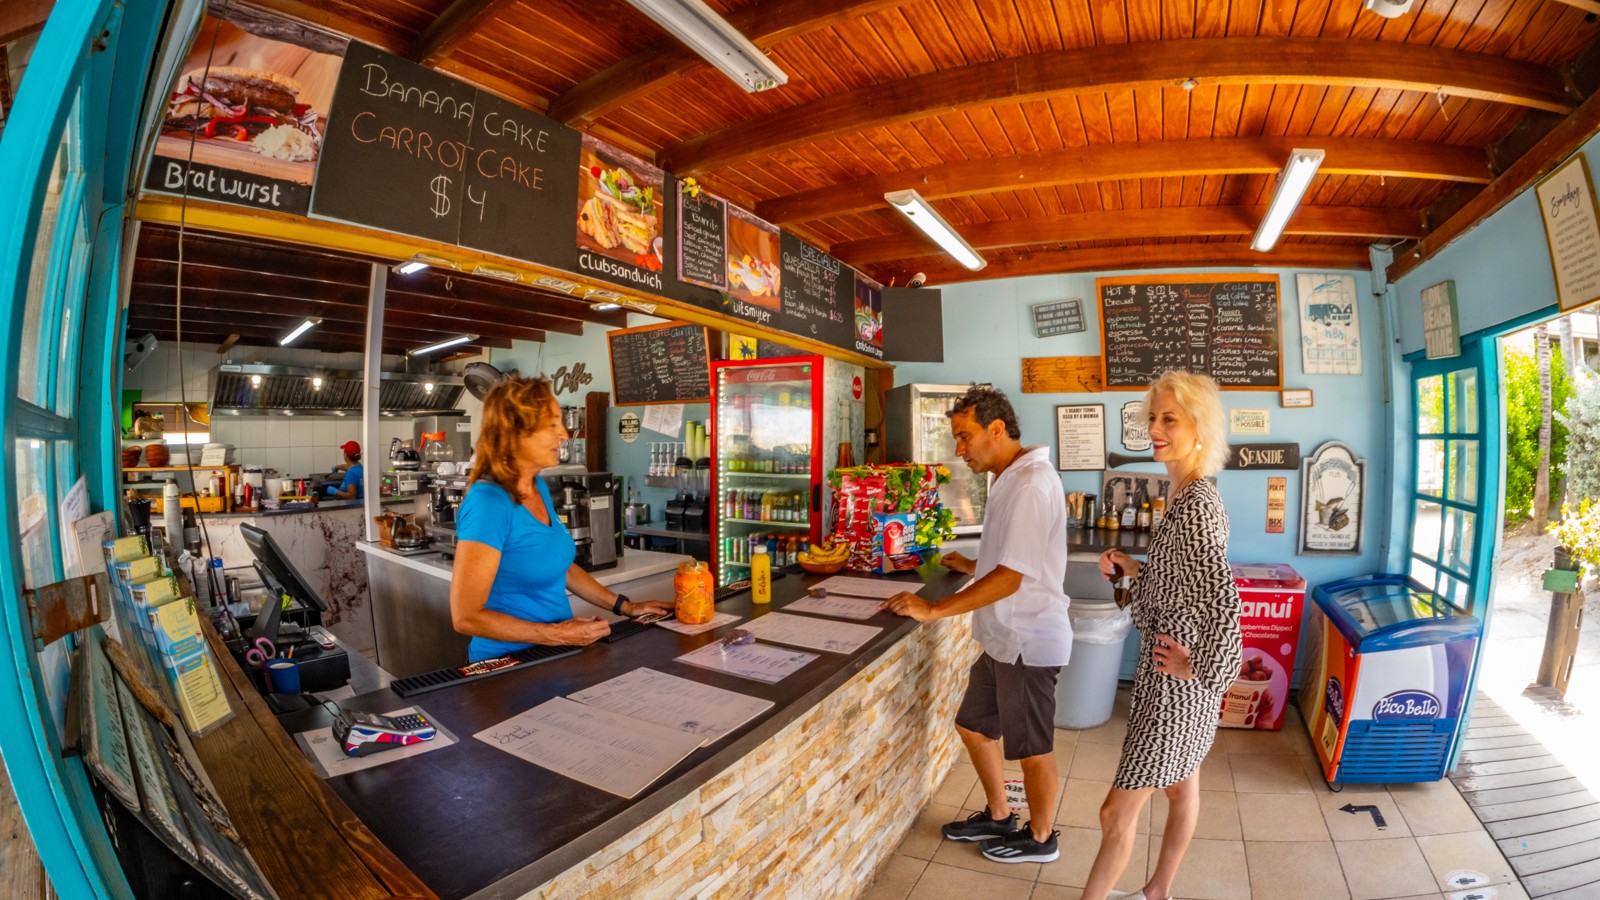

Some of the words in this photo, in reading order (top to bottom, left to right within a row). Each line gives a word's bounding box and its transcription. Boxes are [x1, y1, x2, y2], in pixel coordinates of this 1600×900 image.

[484, 112, 549, 152] CAKE
[352, 112, 474, 172] CARROT
[477, 150, 544, 190] CAKE
[430, 174, 452, 218] $
[468, 184, 486, 222] 4
[579, 254, 662, 290] Clubsandwich
[803, 244, 838, 272] SPECIALS
[551, 363, 593, 396] Coffee
[1124, 426, 1150, 440] MISTAKE
[1378, 698, 1404, 714] Pico
[1406, 699, 1438, 716] Bello
